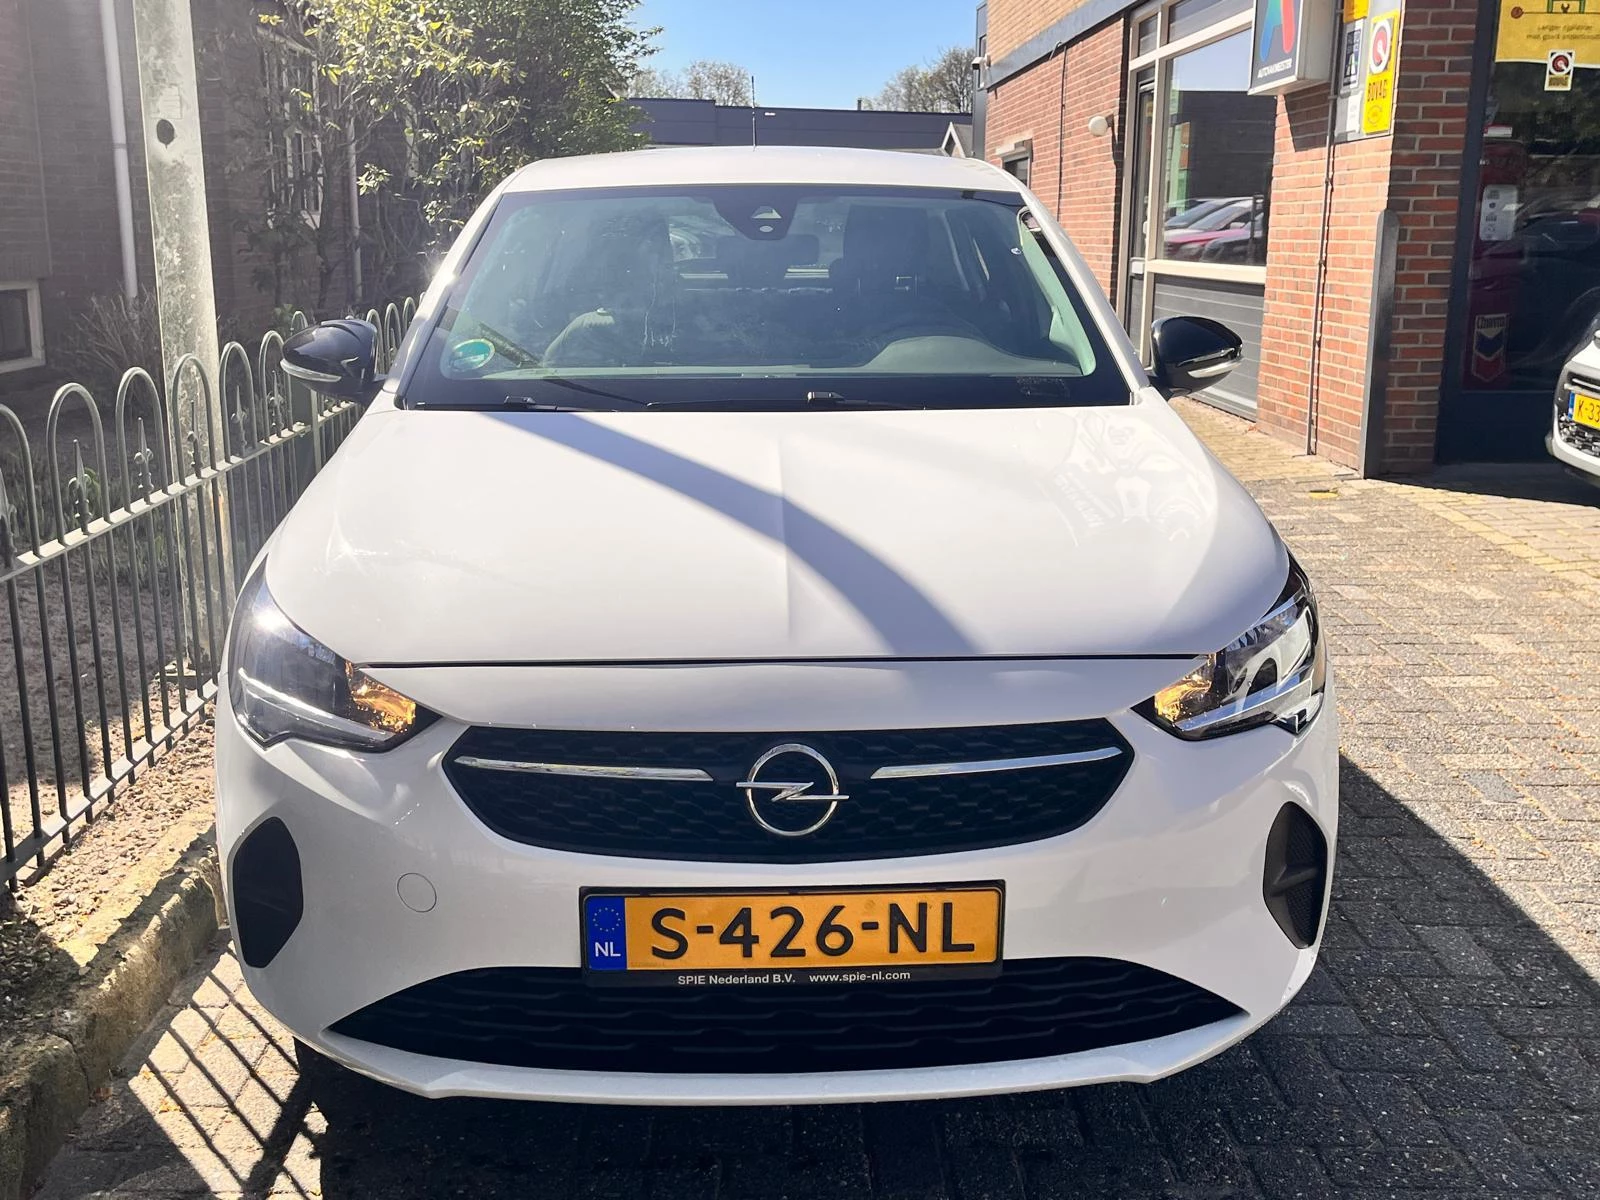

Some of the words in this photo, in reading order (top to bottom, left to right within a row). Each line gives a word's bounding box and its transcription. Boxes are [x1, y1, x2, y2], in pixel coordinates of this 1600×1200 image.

[651, 902, 975, 960] S-426-NL
[594, 941, 621, 957] NL
[677, 975, 706, 985] SPIE
[709, 974, 769, 984] Nederland
[772, 973, 796, 983] B.V.
[809, 971, 911, 983] www.spie-nl.com
